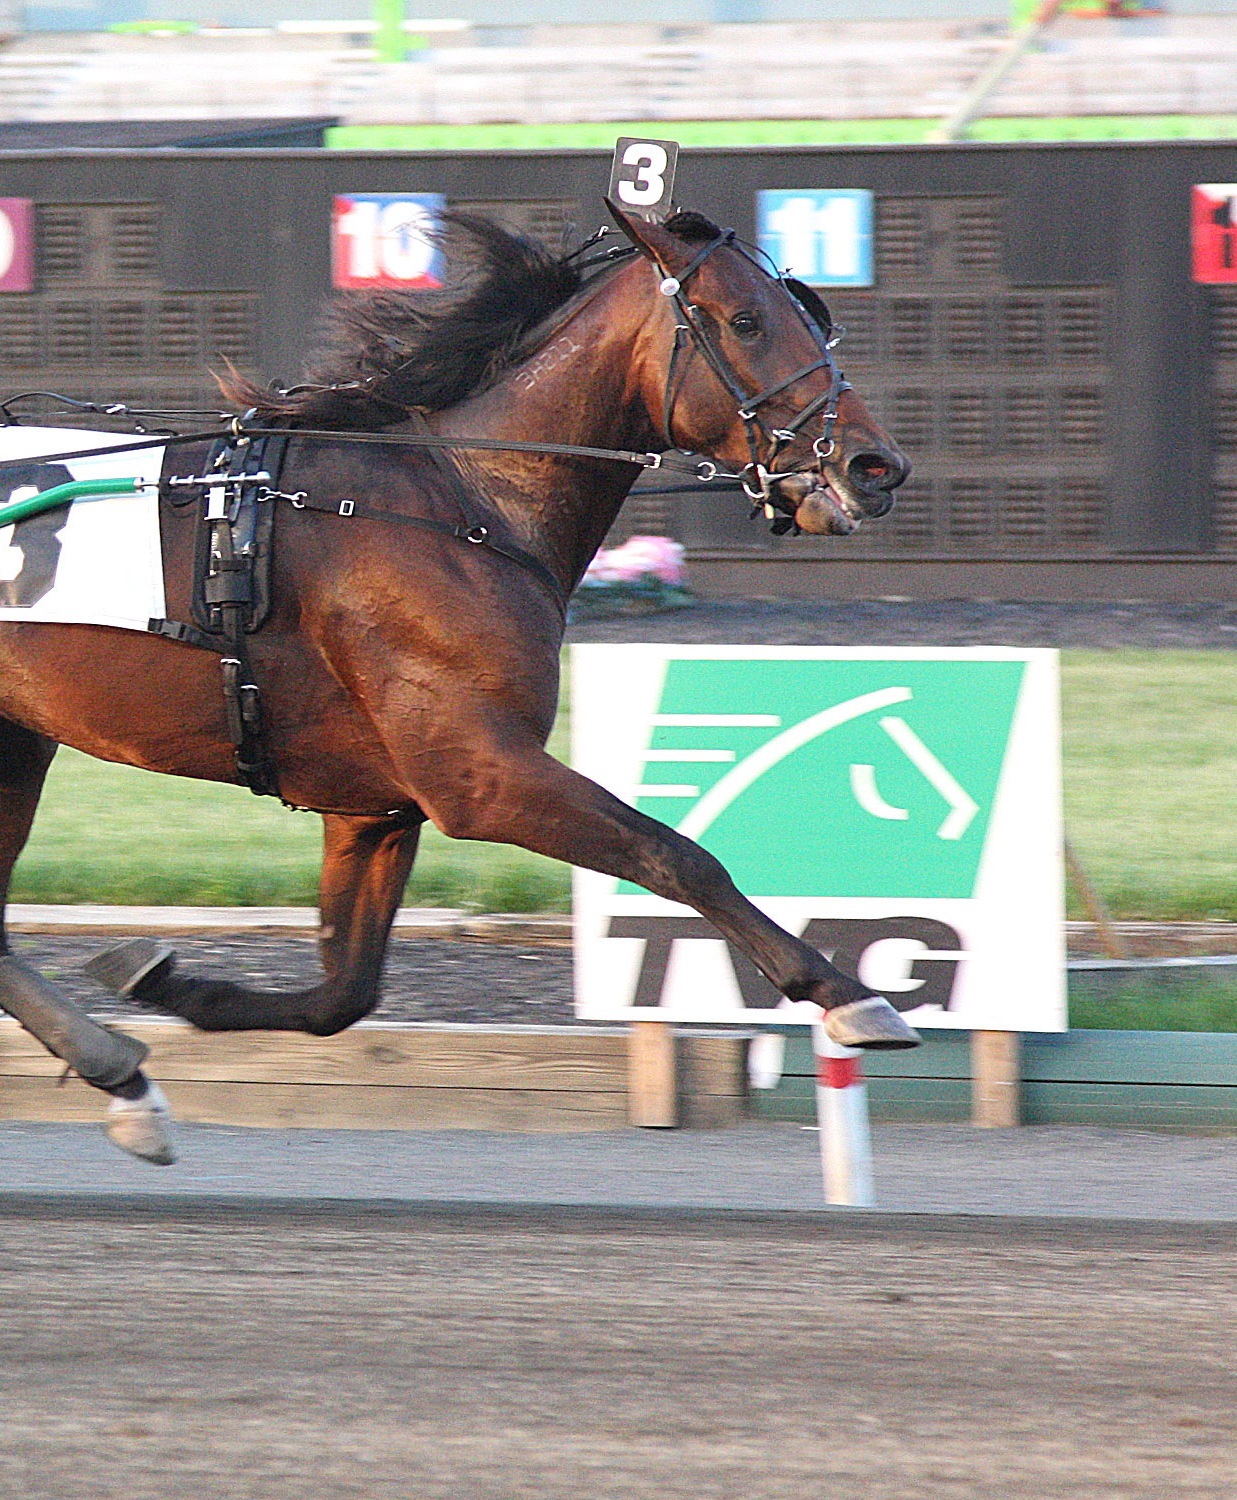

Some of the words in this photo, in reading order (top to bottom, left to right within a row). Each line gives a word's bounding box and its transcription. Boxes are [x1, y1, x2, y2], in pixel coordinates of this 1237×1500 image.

[617, 143, 666, 206] 3
[337, 200, 434, 280] 10
[767, 196, 858, 277] 11
